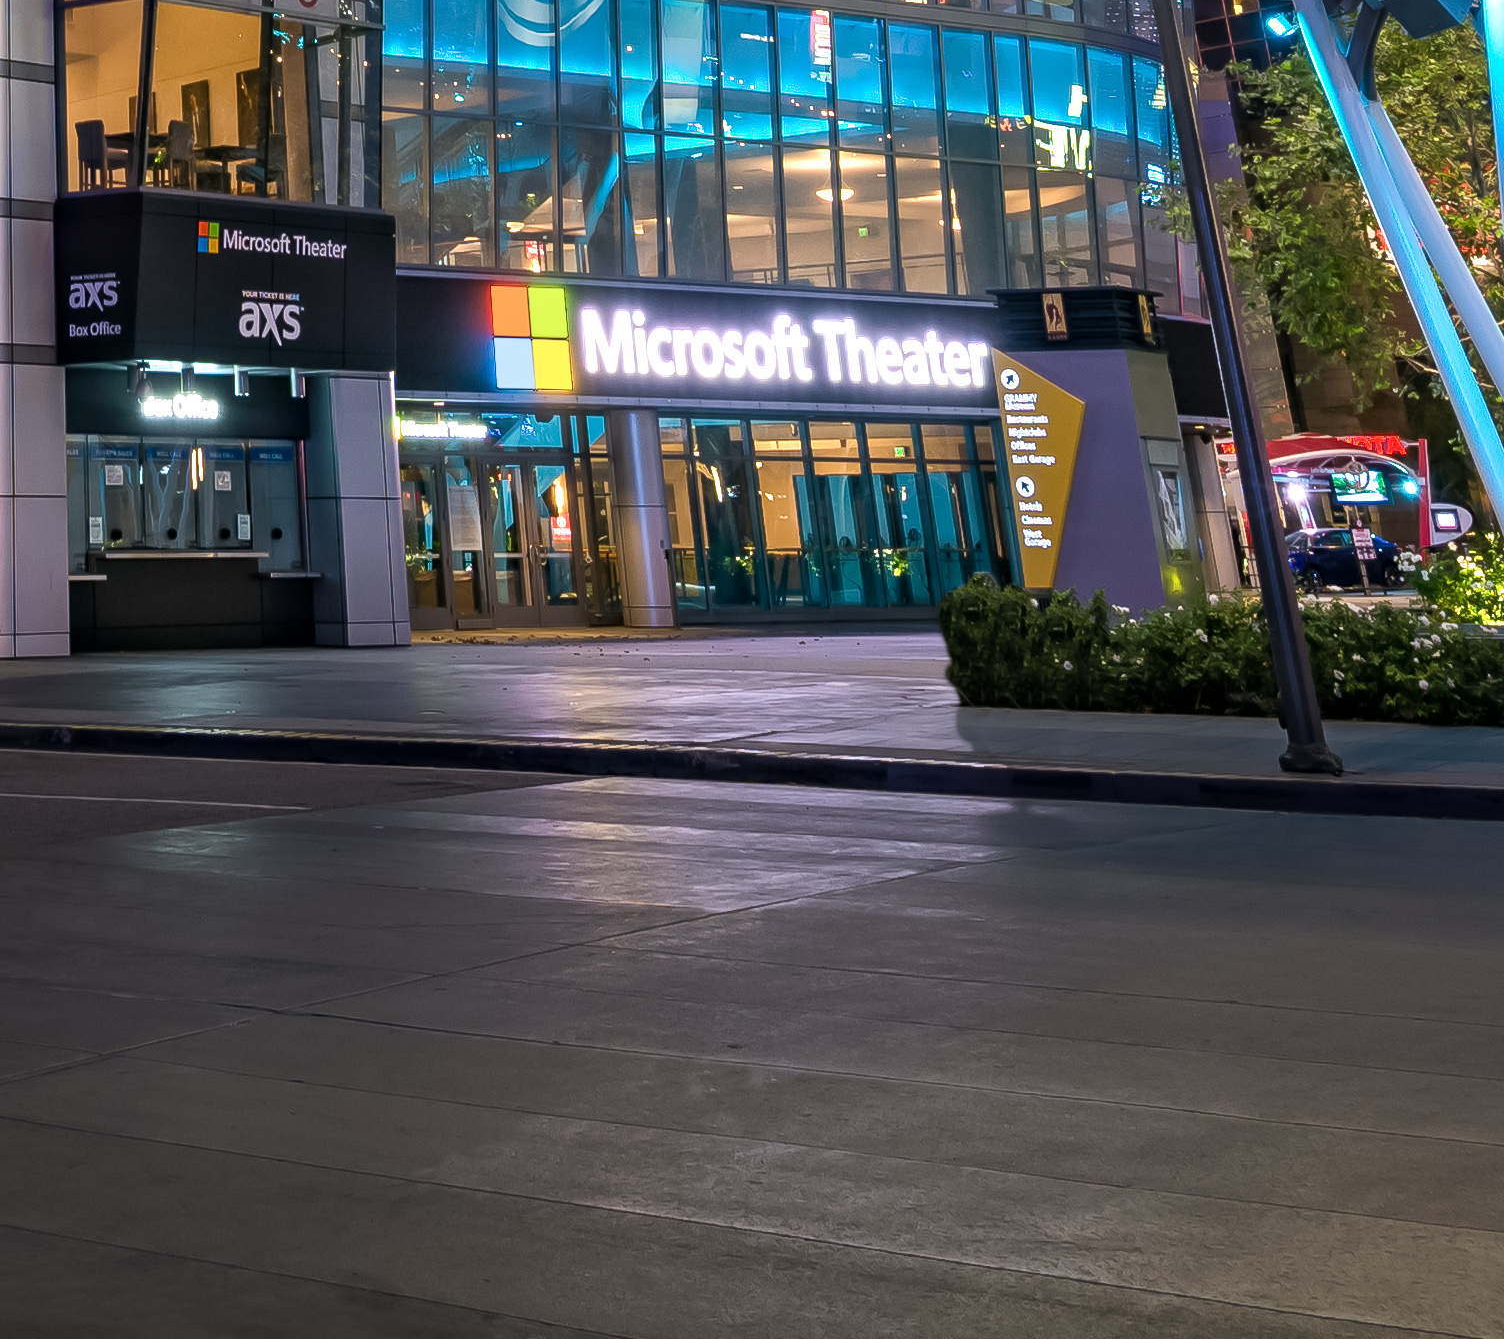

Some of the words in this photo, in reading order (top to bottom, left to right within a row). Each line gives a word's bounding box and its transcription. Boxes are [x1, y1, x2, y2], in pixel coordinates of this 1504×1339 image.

[222, 228, 291, 255] Microsoft
[292, 234, 347, 259] Theater
[69, 280, 118, 312] axs
[69, 324, 89, 337] Box
[89, 321, 122, 336] Office
[238, 301, 301, 347] axs
[580, 306, 813, 381] Microsoft
[813, 316, 989, 387] Theater
